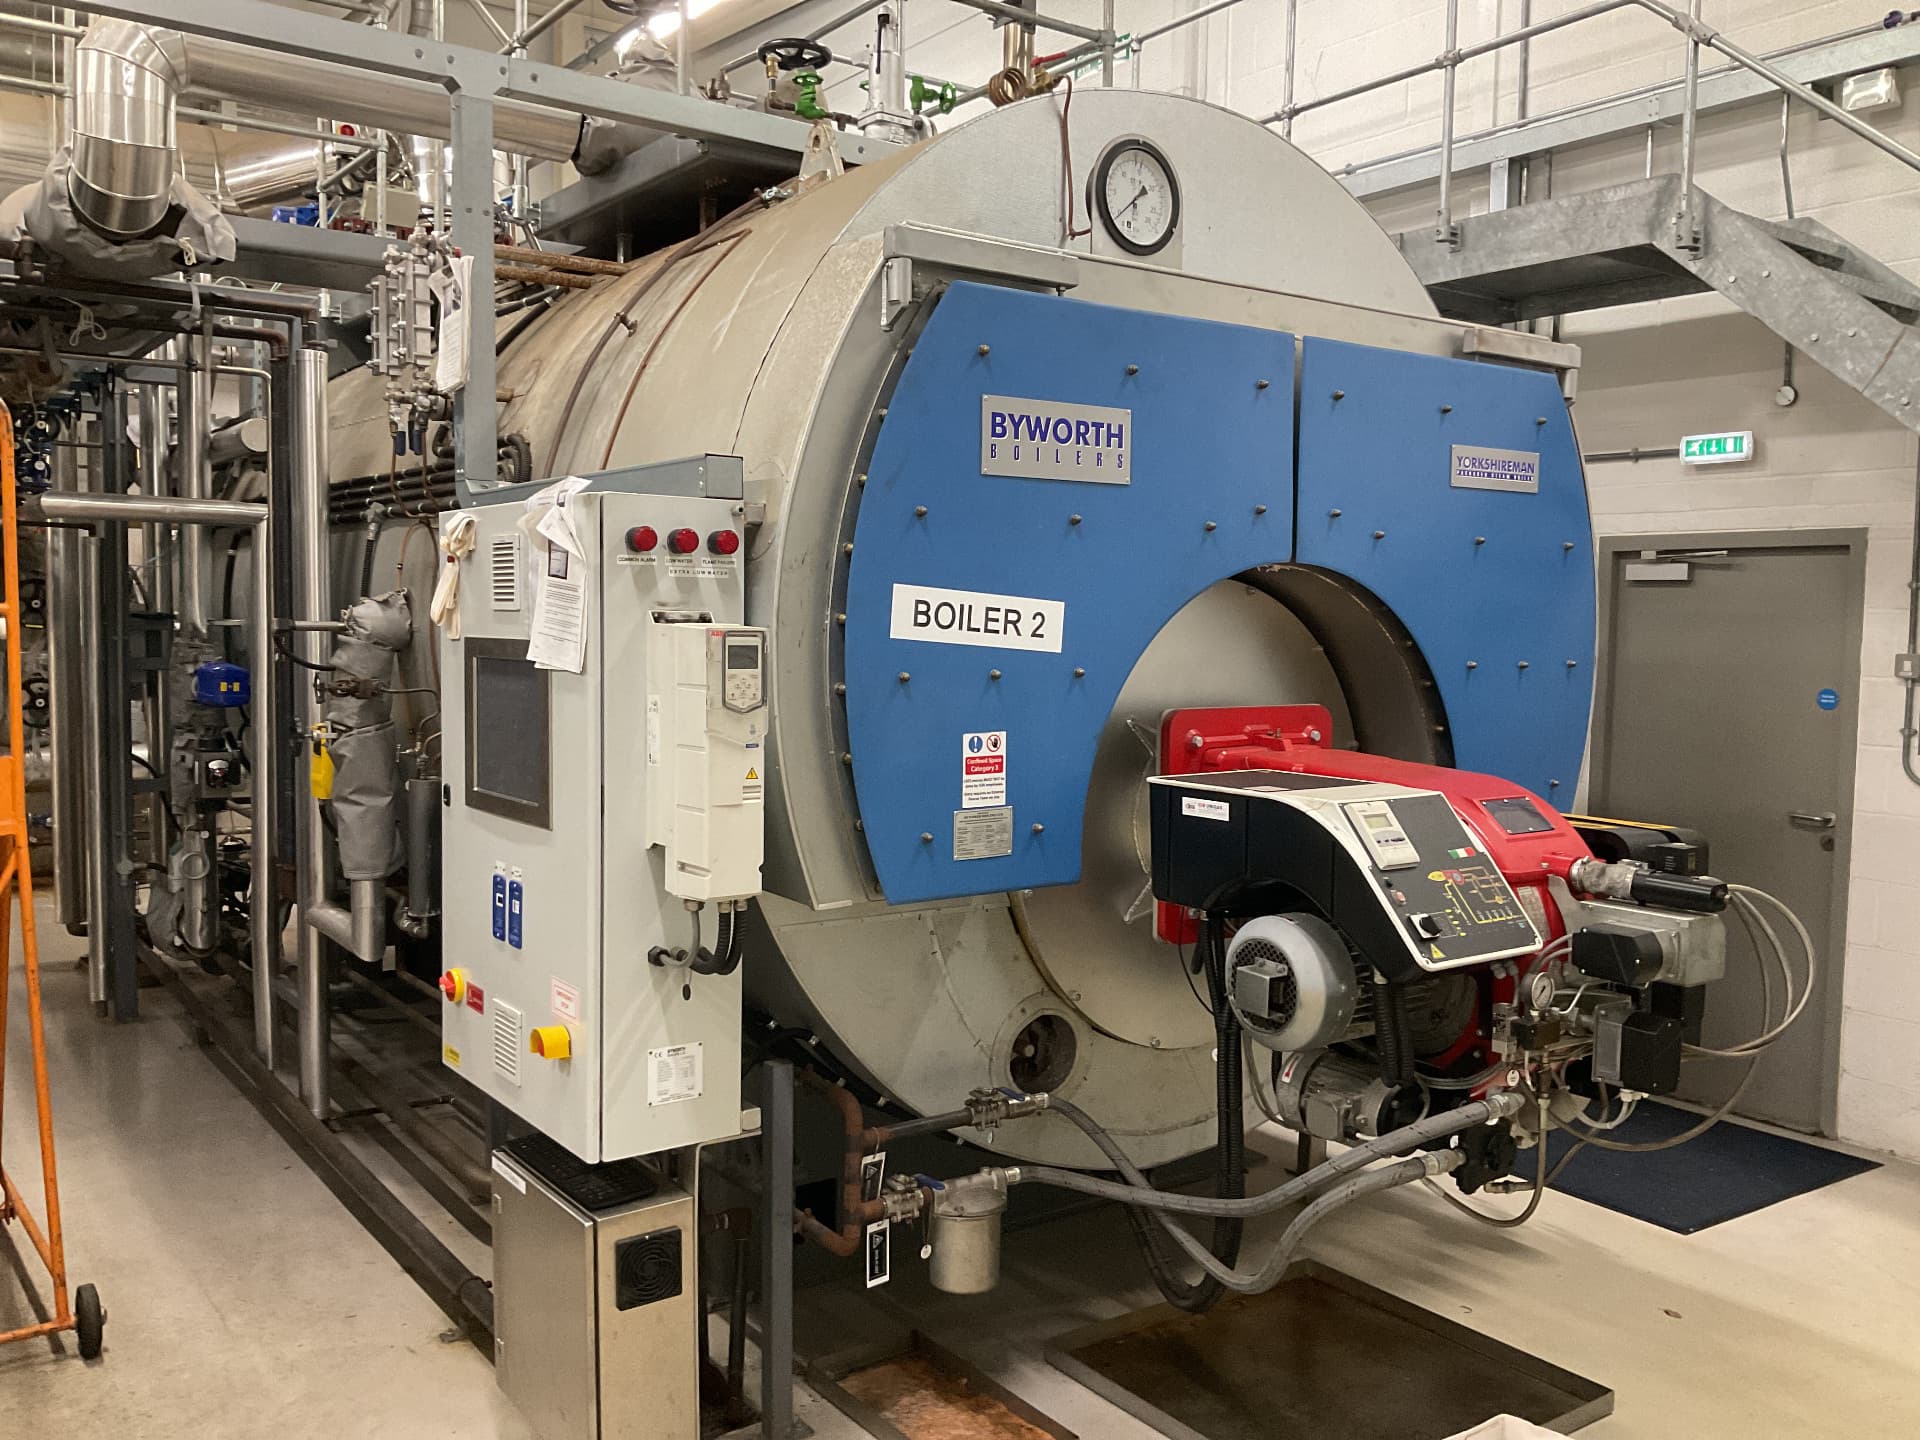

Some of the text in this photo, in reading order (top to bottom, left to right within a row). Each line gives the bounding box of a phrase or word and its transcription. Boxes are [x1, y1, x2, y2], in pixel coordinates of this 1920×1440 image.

[991, 411, 1125, 449] BYWORTH
[991, 443, 1123, 469] BOILERS
[1456, 456, 1535, 474] YORKSHIREMAN
[913, 599, 1046, 639] BOILER 2
[970, 764, 994, 773] Category
